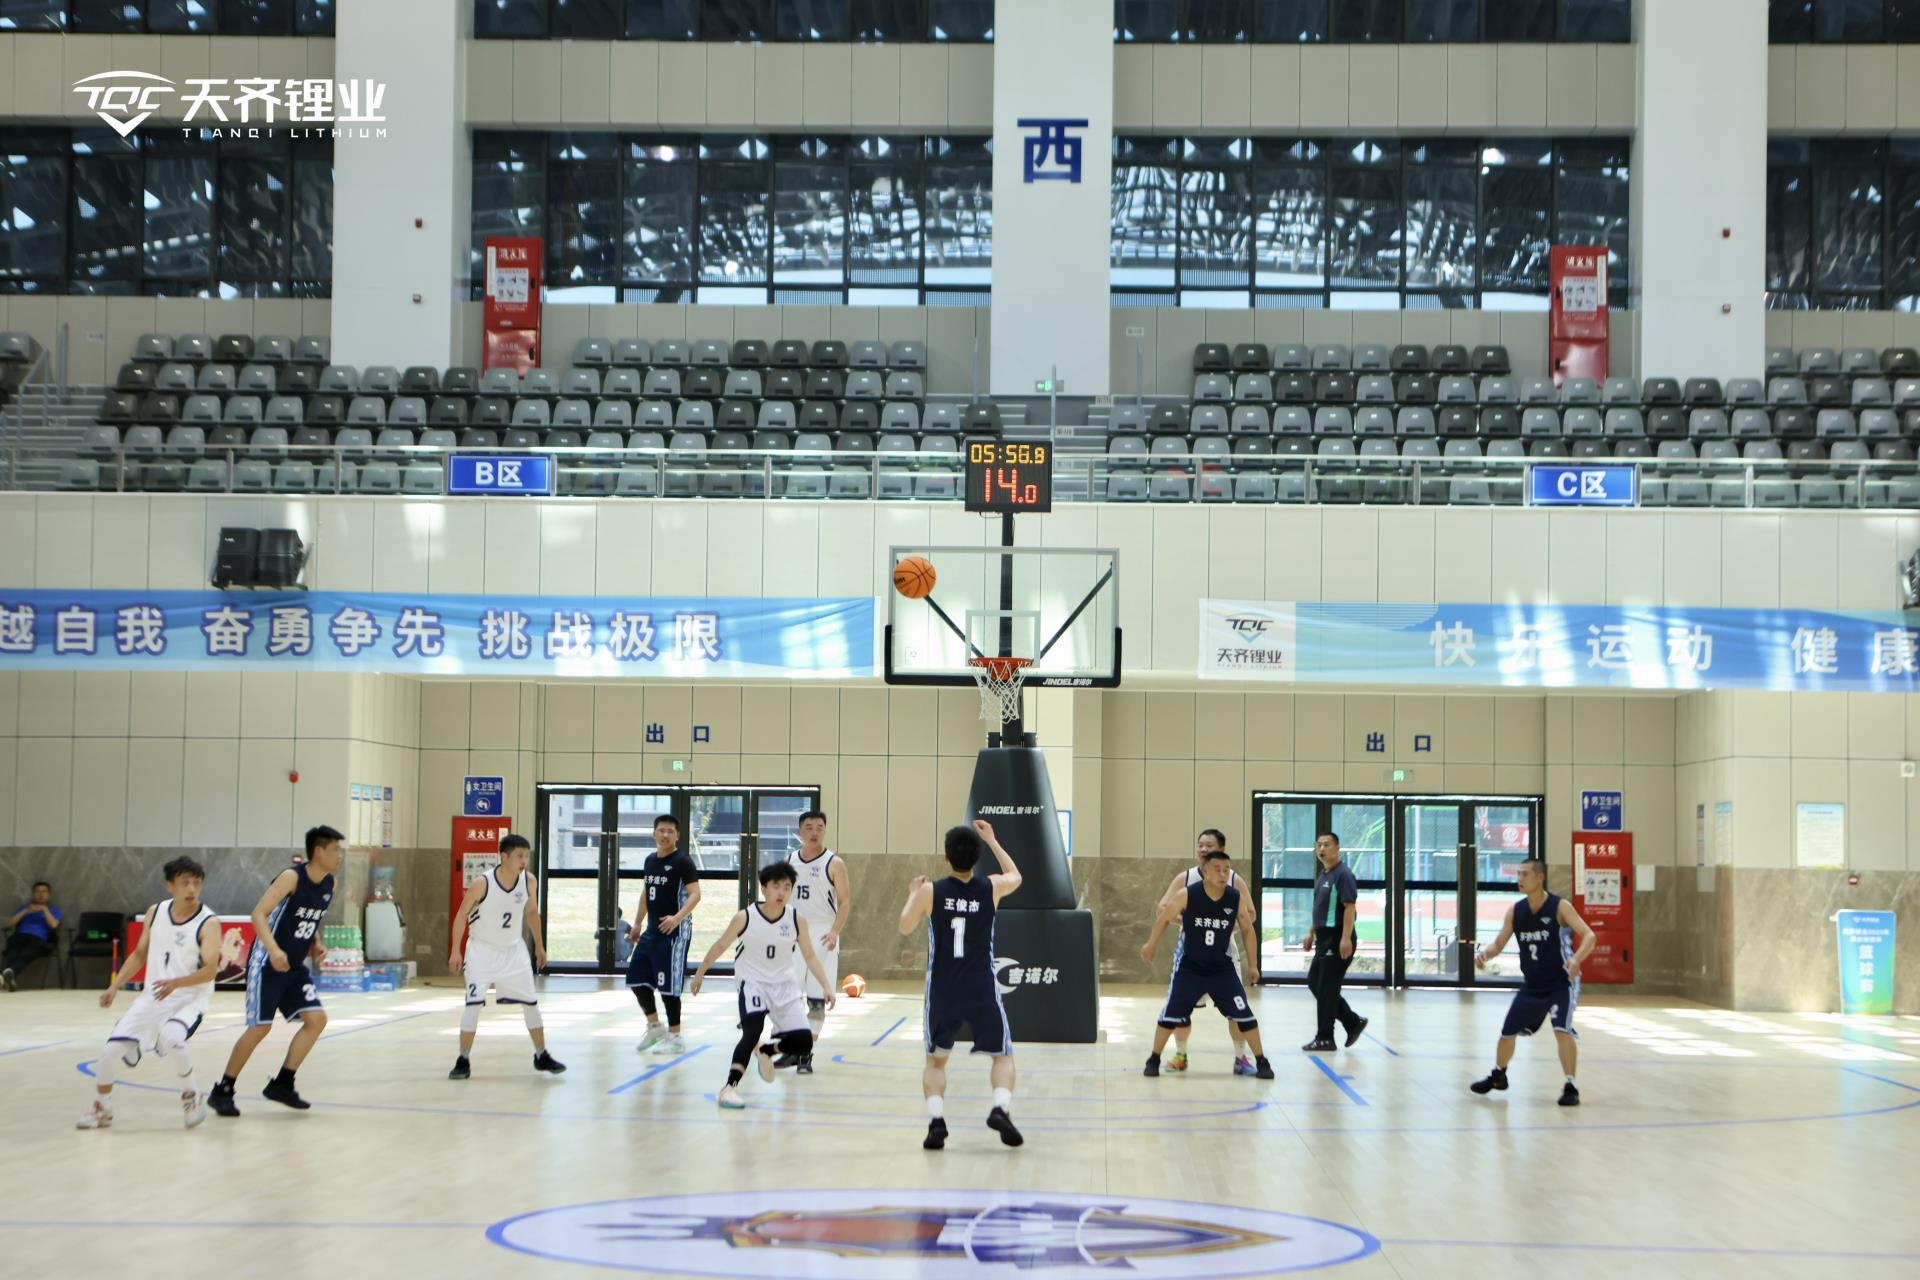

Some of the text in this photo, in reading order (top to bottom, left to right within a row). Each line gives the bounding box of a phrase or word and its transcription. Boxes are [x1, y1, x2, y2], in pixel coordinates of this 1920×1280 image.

[1017, 118, 1089, 183] 西
[475, 460, 523, 487] B区
[985, 467, 1037, 504] 14.0
[1557, 470, 1608, 498] C区
[0, 604, 723, 661] 越自我 奋勇争先 挑战极限
[1217, 648, 1282, 664] 天齐锂业
[1430, 620, 1919, 676] 快乐运动 健康
[646, 722, 709, 744] 出口
[1366, 731, 1431, 753] 出口
[472, 781, 502, 791] 女卫生间
[649, 886, 656, 901] 9
[797, 885, 810, 899] 15
[944, 898, 980, 913] 王俊杰
[502, 912, 512, 929] 2
[1194, 917, 1229, 930] 天齐遂宁
[294, 920, 316, 940] 33
[951, 917, 966, 958] 1
[1205, 930, 1215, 946] 8
[164, 951, 171, 969] 1
[766, 945, 775, 959] 0
[1529, 944, 1539, 960] 2
[657, 971, 665, 986] 9
[1008, 967, 1059, 984] 吉诺尔
[469, 983, 477, 997] 2
[1233, 996, 1246, 1010] 8
